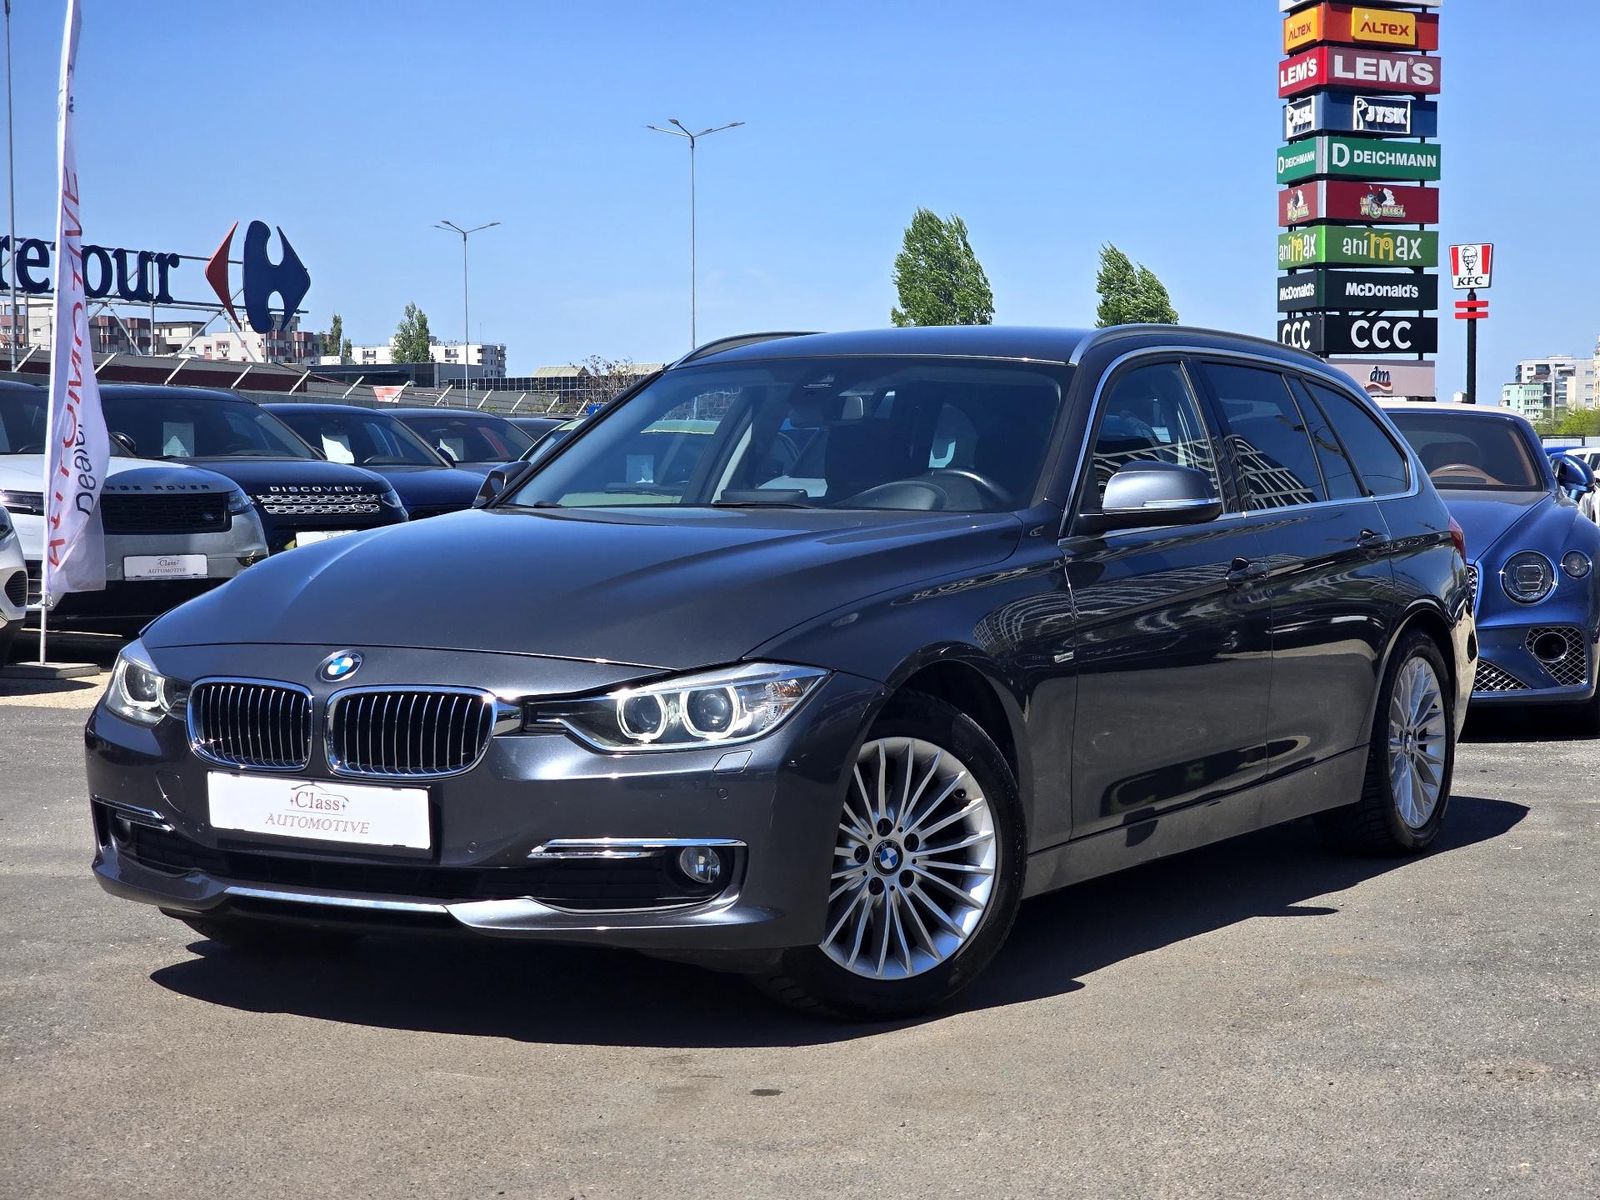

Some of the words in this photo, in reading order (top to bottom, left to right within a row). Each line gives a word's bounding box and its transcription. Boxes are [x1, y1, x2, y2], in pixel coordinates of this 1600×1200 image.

[1365, 105, 1407, 125] JYSK
[1285, 150, 1315, 169] DEICHMANN
[1332, 143, 1350, 168] D
[1353, 150, 1437, 168] DEICHMANN
[1279, 232, 1317, 262] animax
[1342, 231, 1422, 262] animax
[0, 235, 180, 304] eour
[1279, 282, 1315, 301] McDonald's
[1345, 282, 1419, 299] McDonald's
[1456, 276, 1484, 287] KFC
[1281, 320, 1311, 350] CCC
[1350, 319, 1412, 349] CCC
[1369, 366, 1390, 382] dm
[153, 484, 211, 492] ROVER
[148, 566, 187, 574] AUTOMOTIVE
[295, 790, 340, 811] Class
[265, 813, 370, 834] AUTOMOTIVE
